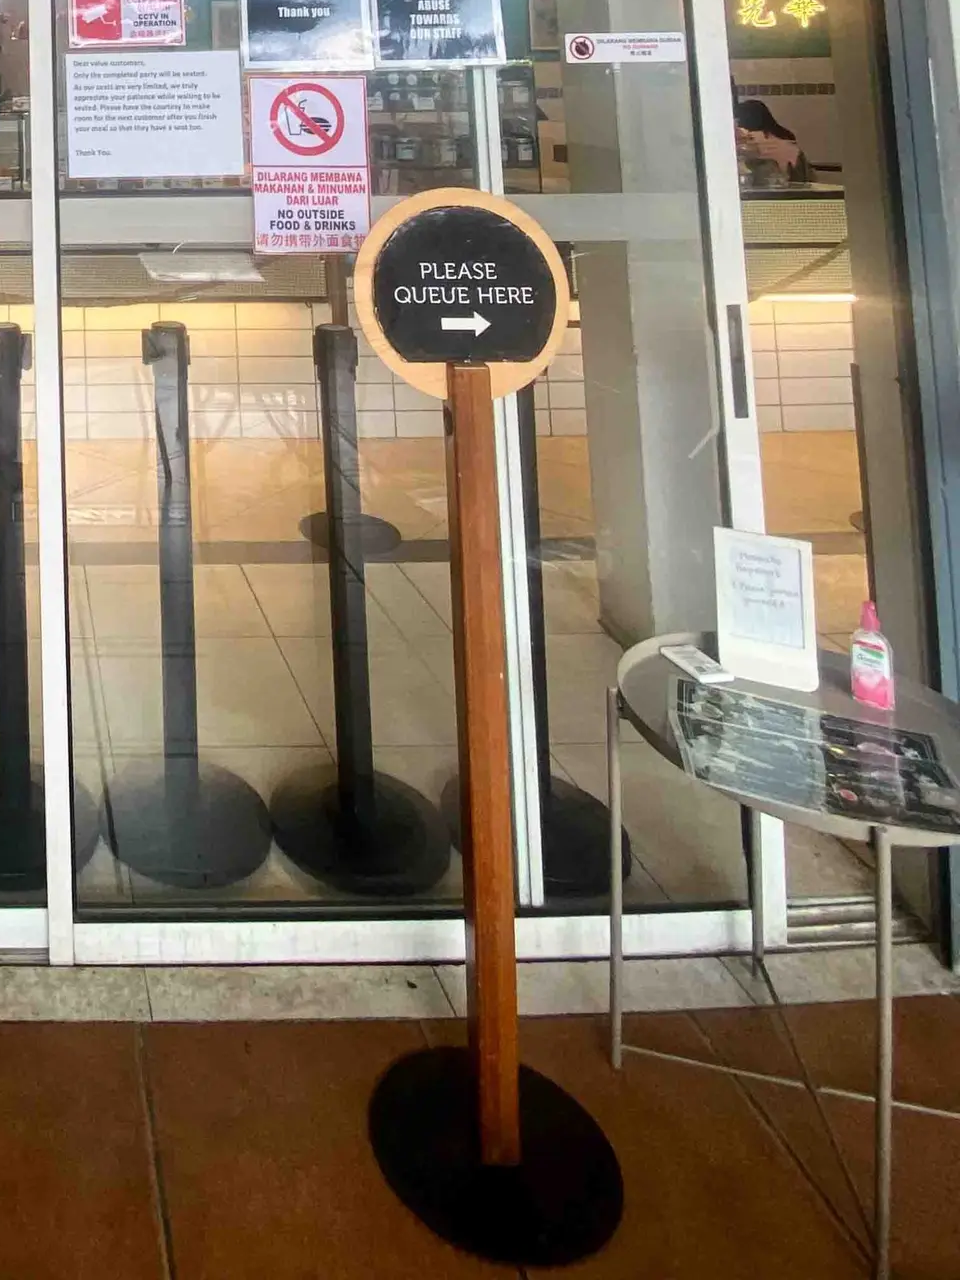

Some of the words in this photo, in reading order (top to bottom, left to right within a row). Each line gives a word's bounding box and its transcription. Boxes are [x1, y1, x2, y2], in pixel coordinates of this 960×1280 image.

[418, 0, 450, 11] ABUSE
[160, 12, 169, 20] IN
[278, 6, 309, 18] Thank
[311, 7, 330, 18] you
[410, 14, 460, 25] TOWARDS
[410, 28, 430, 39] OUR
[432, 27, 462, 39] STAFF
[103, 71, 138, 79] completed
[139, 71, 157, 79] party
[182, 82, 198, 90] truly
[134, 124, 149, 132] they
[257, 172, 308, 182] DILARANG
[310, 172, 362, 182] MEMBAWA
[254, 184, 304, 194] MAKANAN
[308, 184, 315, 194] &
[317, 184, 366, 194] MINUMAN
[286, 196, 309, 206] DARI
[312, 196, 339, 205] LUAR
[277, 209, 295, 219] NO
[297, 209, 344, 219] OUTSIDE
[270, 220, 300, 231] FOOD
[304, 220, 311, 230] &
[315, 220, 356, 231] DRINKS
[419, 262, 497, 280] PLEASE
[394, 286, 470, 304] QUEUE
[477, 286, 534, 304] HERE
